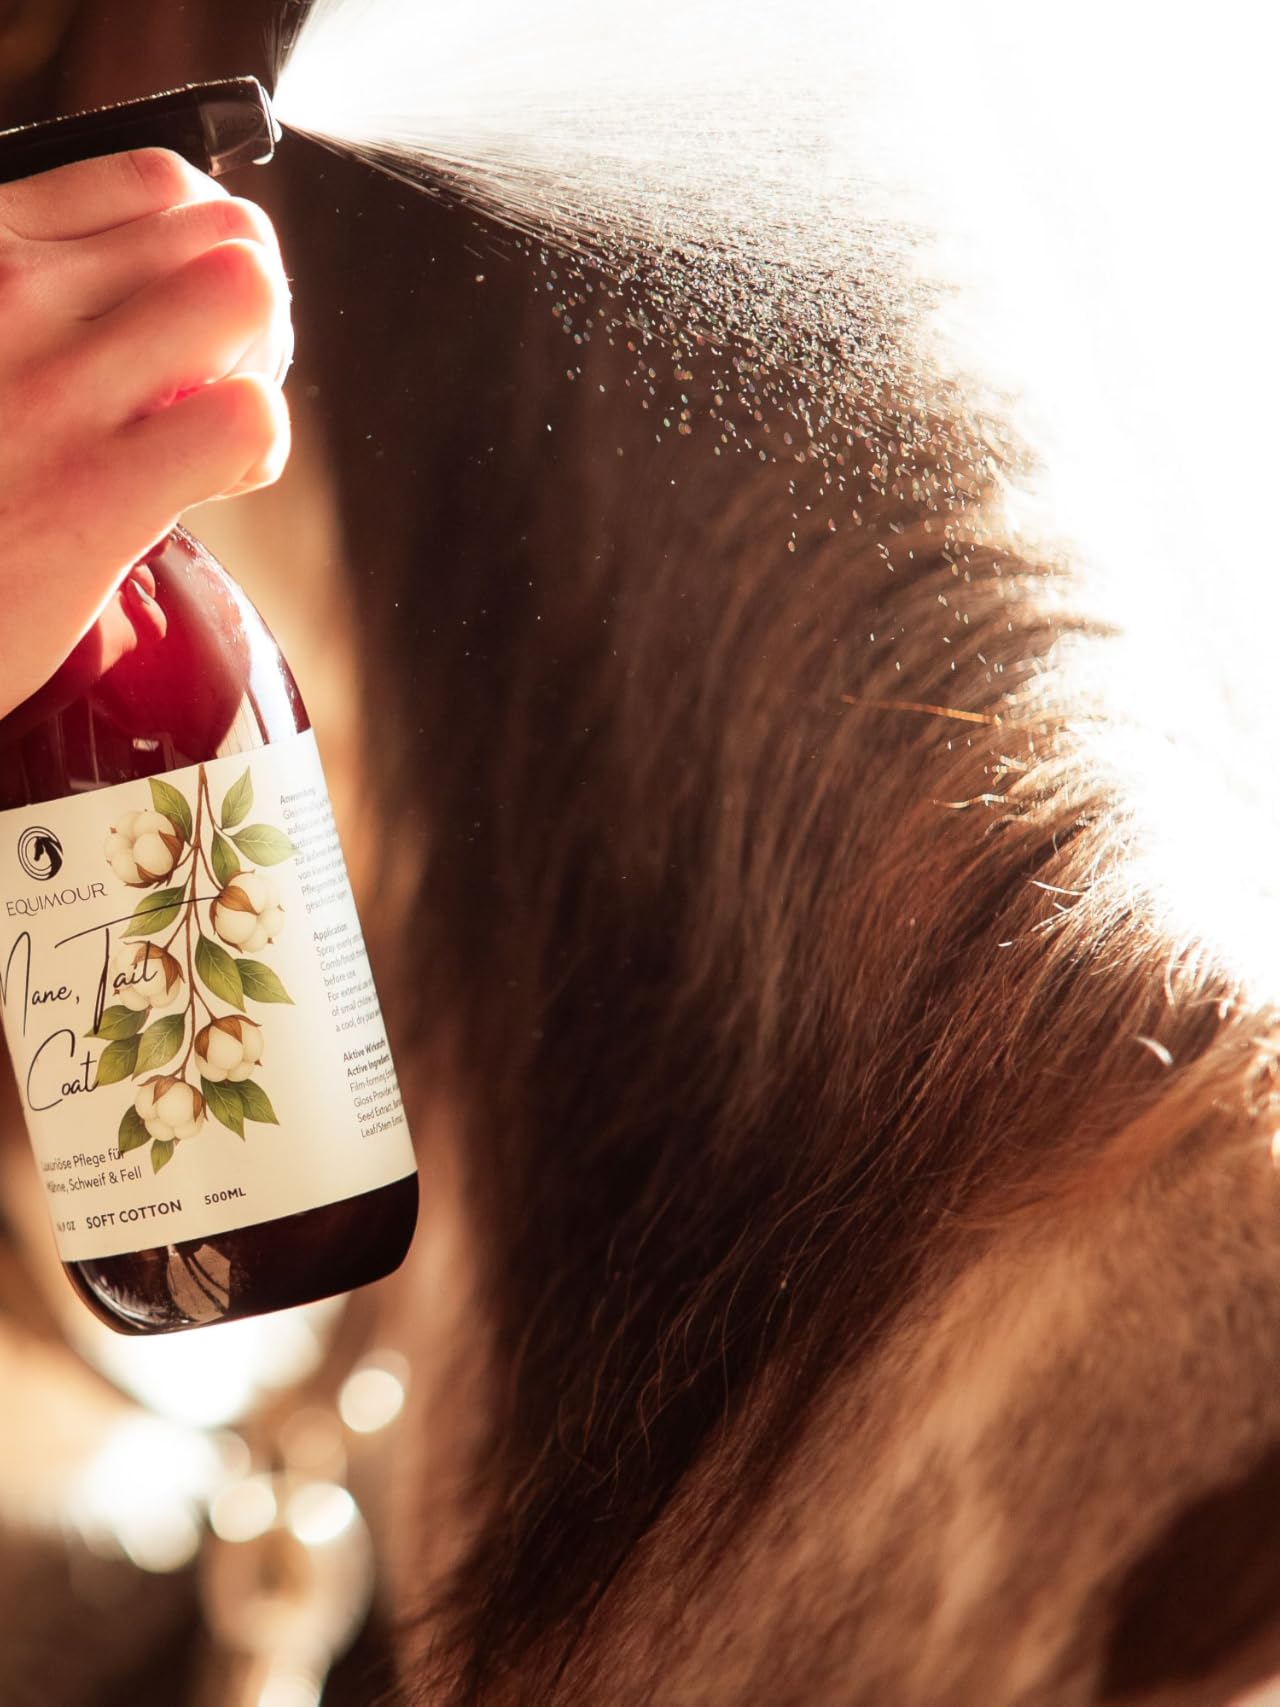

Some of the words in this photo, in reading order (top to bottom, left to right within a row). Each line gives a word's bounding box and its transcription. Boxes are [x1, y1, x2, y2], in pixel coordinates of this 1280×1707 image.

[6, 882, 108, 918] EQUIMOUR
[55, 896, 222, 1035] Tail
[26, 1028, 100, 1111] Coat
[343, 1049, 365, 1062] Aktive
[347, 1064, 368, 1078] Active
[72, 1153, 106, 1169] Pflege
[108, 1147, 126, 1161] für
[68, 1172, 106, 1191] Schweif
[109, 1170, 119, 1184] &
[120, 1165, 143, 1182] Fell
[85, 1212, 117, 1231] SOFT
[118, 1199, 183, 1224] COTTON
[203, 1186, 247, 1206] 500ML
